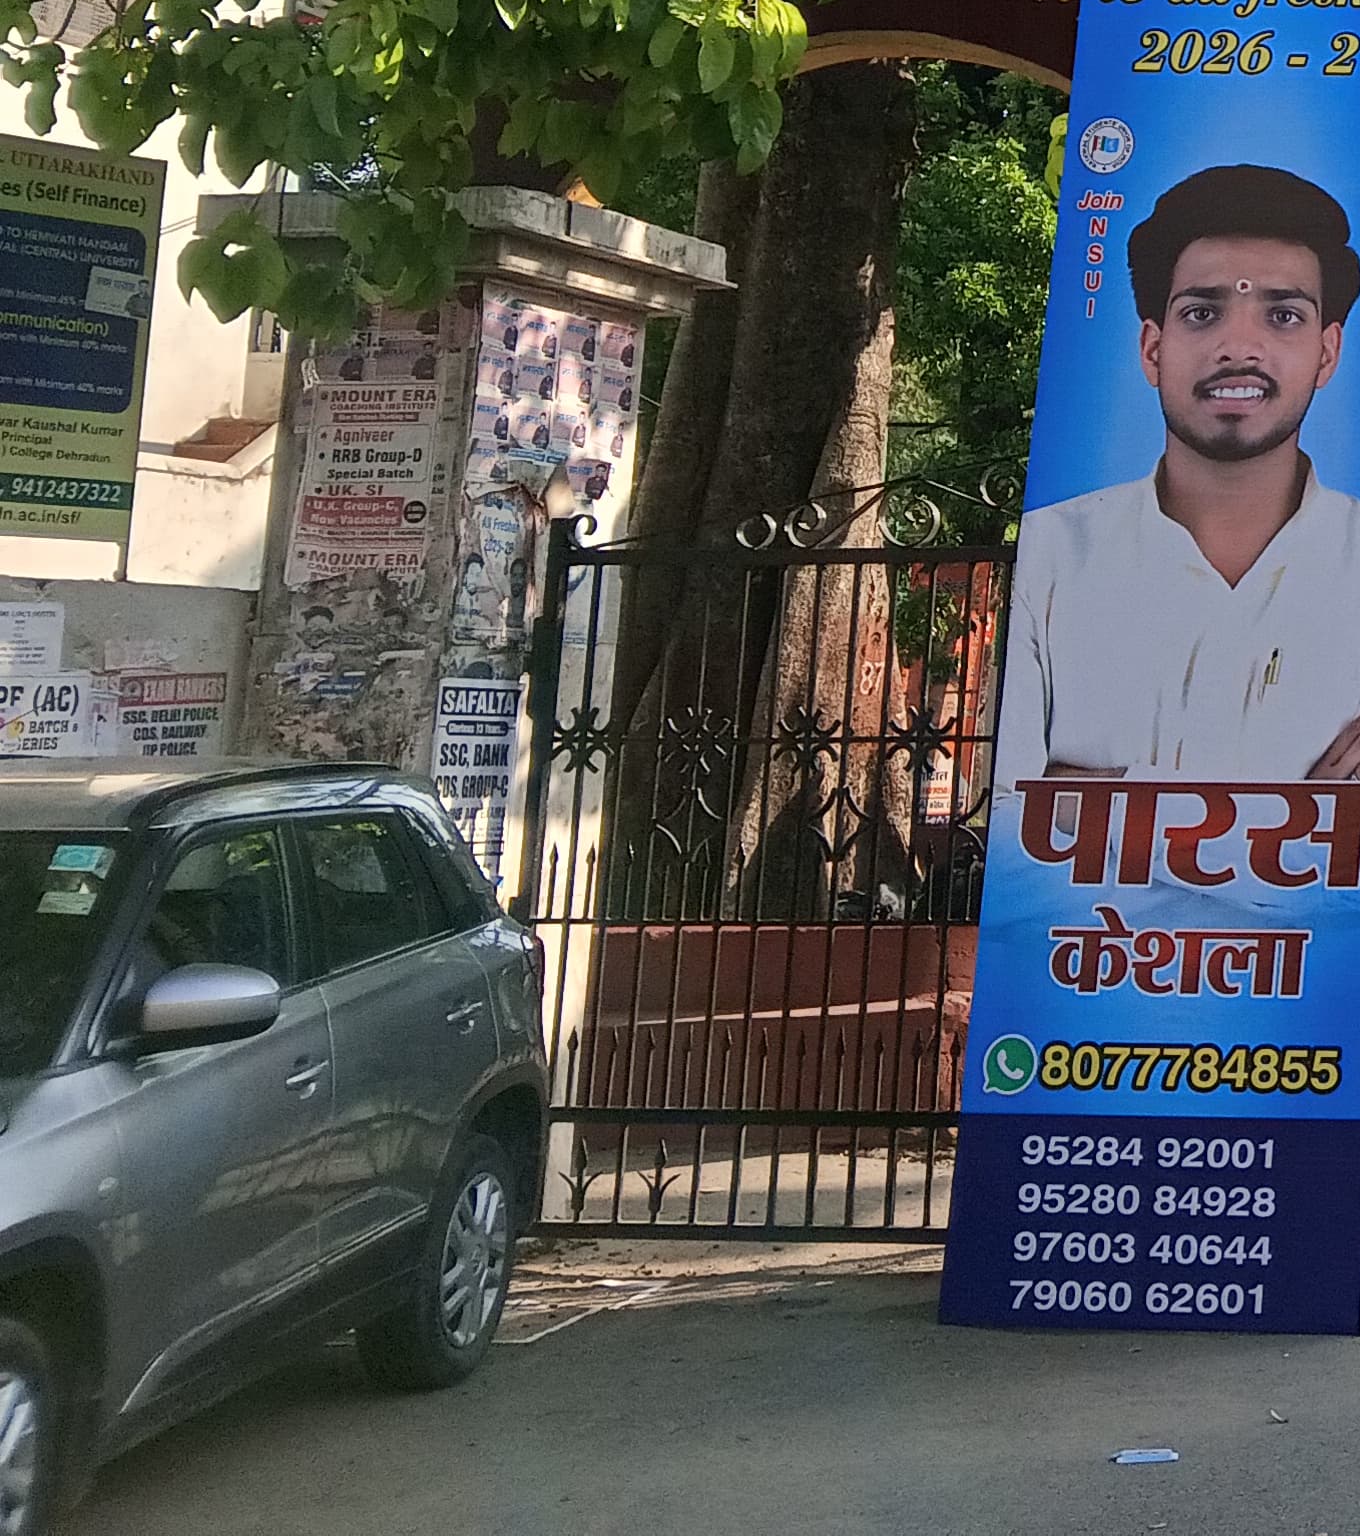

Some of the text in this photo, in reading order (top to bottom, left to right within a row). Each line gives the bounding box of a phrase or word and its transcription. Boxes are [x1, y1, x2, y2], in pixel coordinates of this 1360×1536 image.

[1132, 28, 1276, 76] 2026
[11, 151, 155, 186] UTTARAKHAND
[26, 180, 69, 202] (Self
[73, 187, 146, 218] Finance)
[1077, 188, 1124, 210] Join
[330, 388, 437, 403] MOUNT ERA
[2, 431, 53, 446] Principal
[22, 417, 124, 437] Kaushal Kumar
[333, 428, 394, 448] Agniveer
[10, 447, 111, 464] College Dehradun
[332, 448, 362, 463] RRB
[327, 468, 414, 480] Special Batch
[12, 478, 121, 502] 9412437322
[308, 550, 420, 566] MOUNT ERA
[33, 684, 79, 715] (AC)
[443, 689, 515, 714] SAFALTA
[28, 720, 69, 734] BATCH
[440, 743, 509, 768] SSC, BANK
[462, 775, 508, 798] GROUP-C
[1048, 905, 1311, 998] केशला
[1040, 1041, 1342, 1094] 8077784855
[1021, 1134, 1276, 1170] 95284 92001
[1017, 1183, 1276, 1218] 95280 84928
[1013, 1231, 1273, 1266] 97603 40644
[1009, 1279, 1265, 1315] 79060 62601
